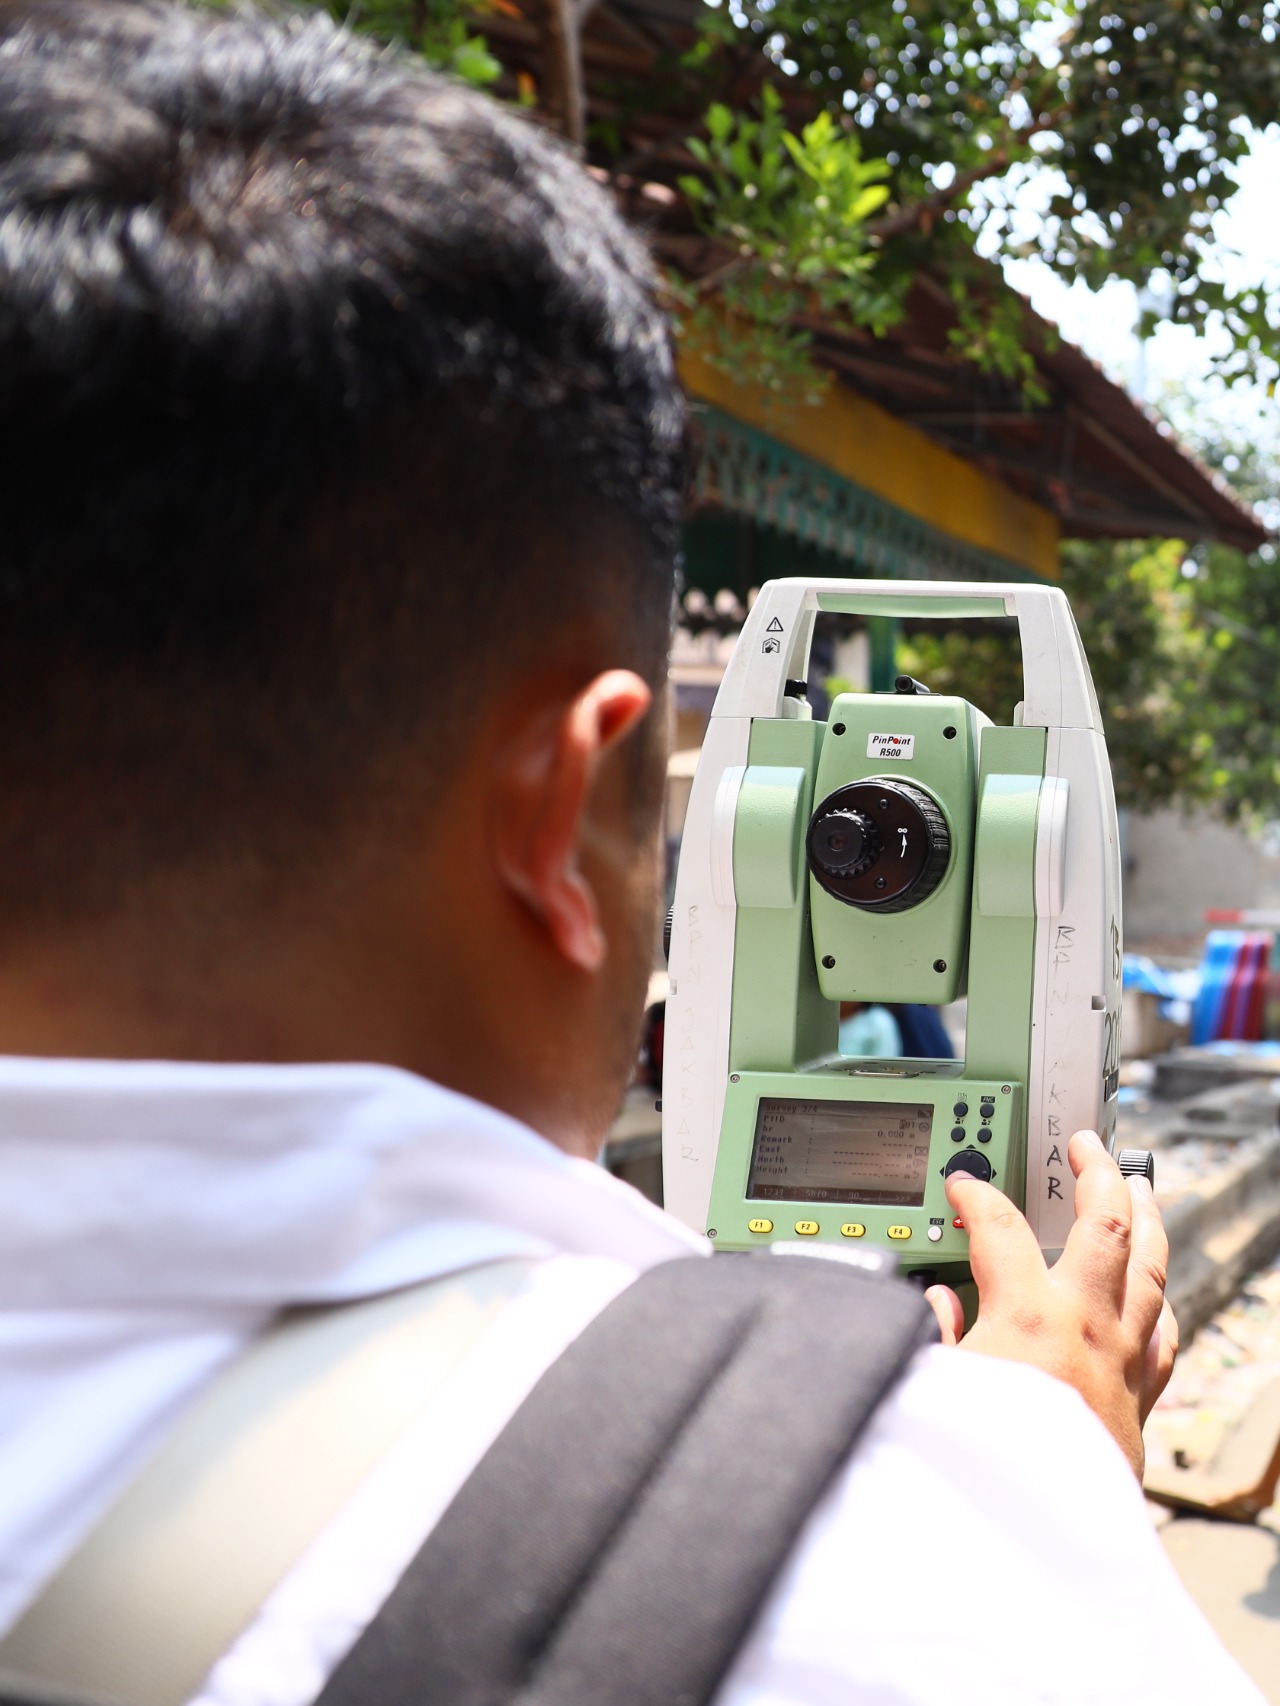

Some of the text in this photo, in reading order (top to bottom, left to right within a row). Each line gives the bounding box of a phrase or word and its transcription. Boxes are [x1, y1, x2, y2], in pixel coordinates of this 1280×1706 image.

[872, 735, 911, 745] PinPoint
[880, 748, 902, 757] R500
[765, 1104, 797, 1114] Survey
[760, 1134, 792, 1143] Remark
[758, 1144, 780, 1153] East
[757, 1155, 784, 1163] North
[755, 1165, 788, 1174] Height
